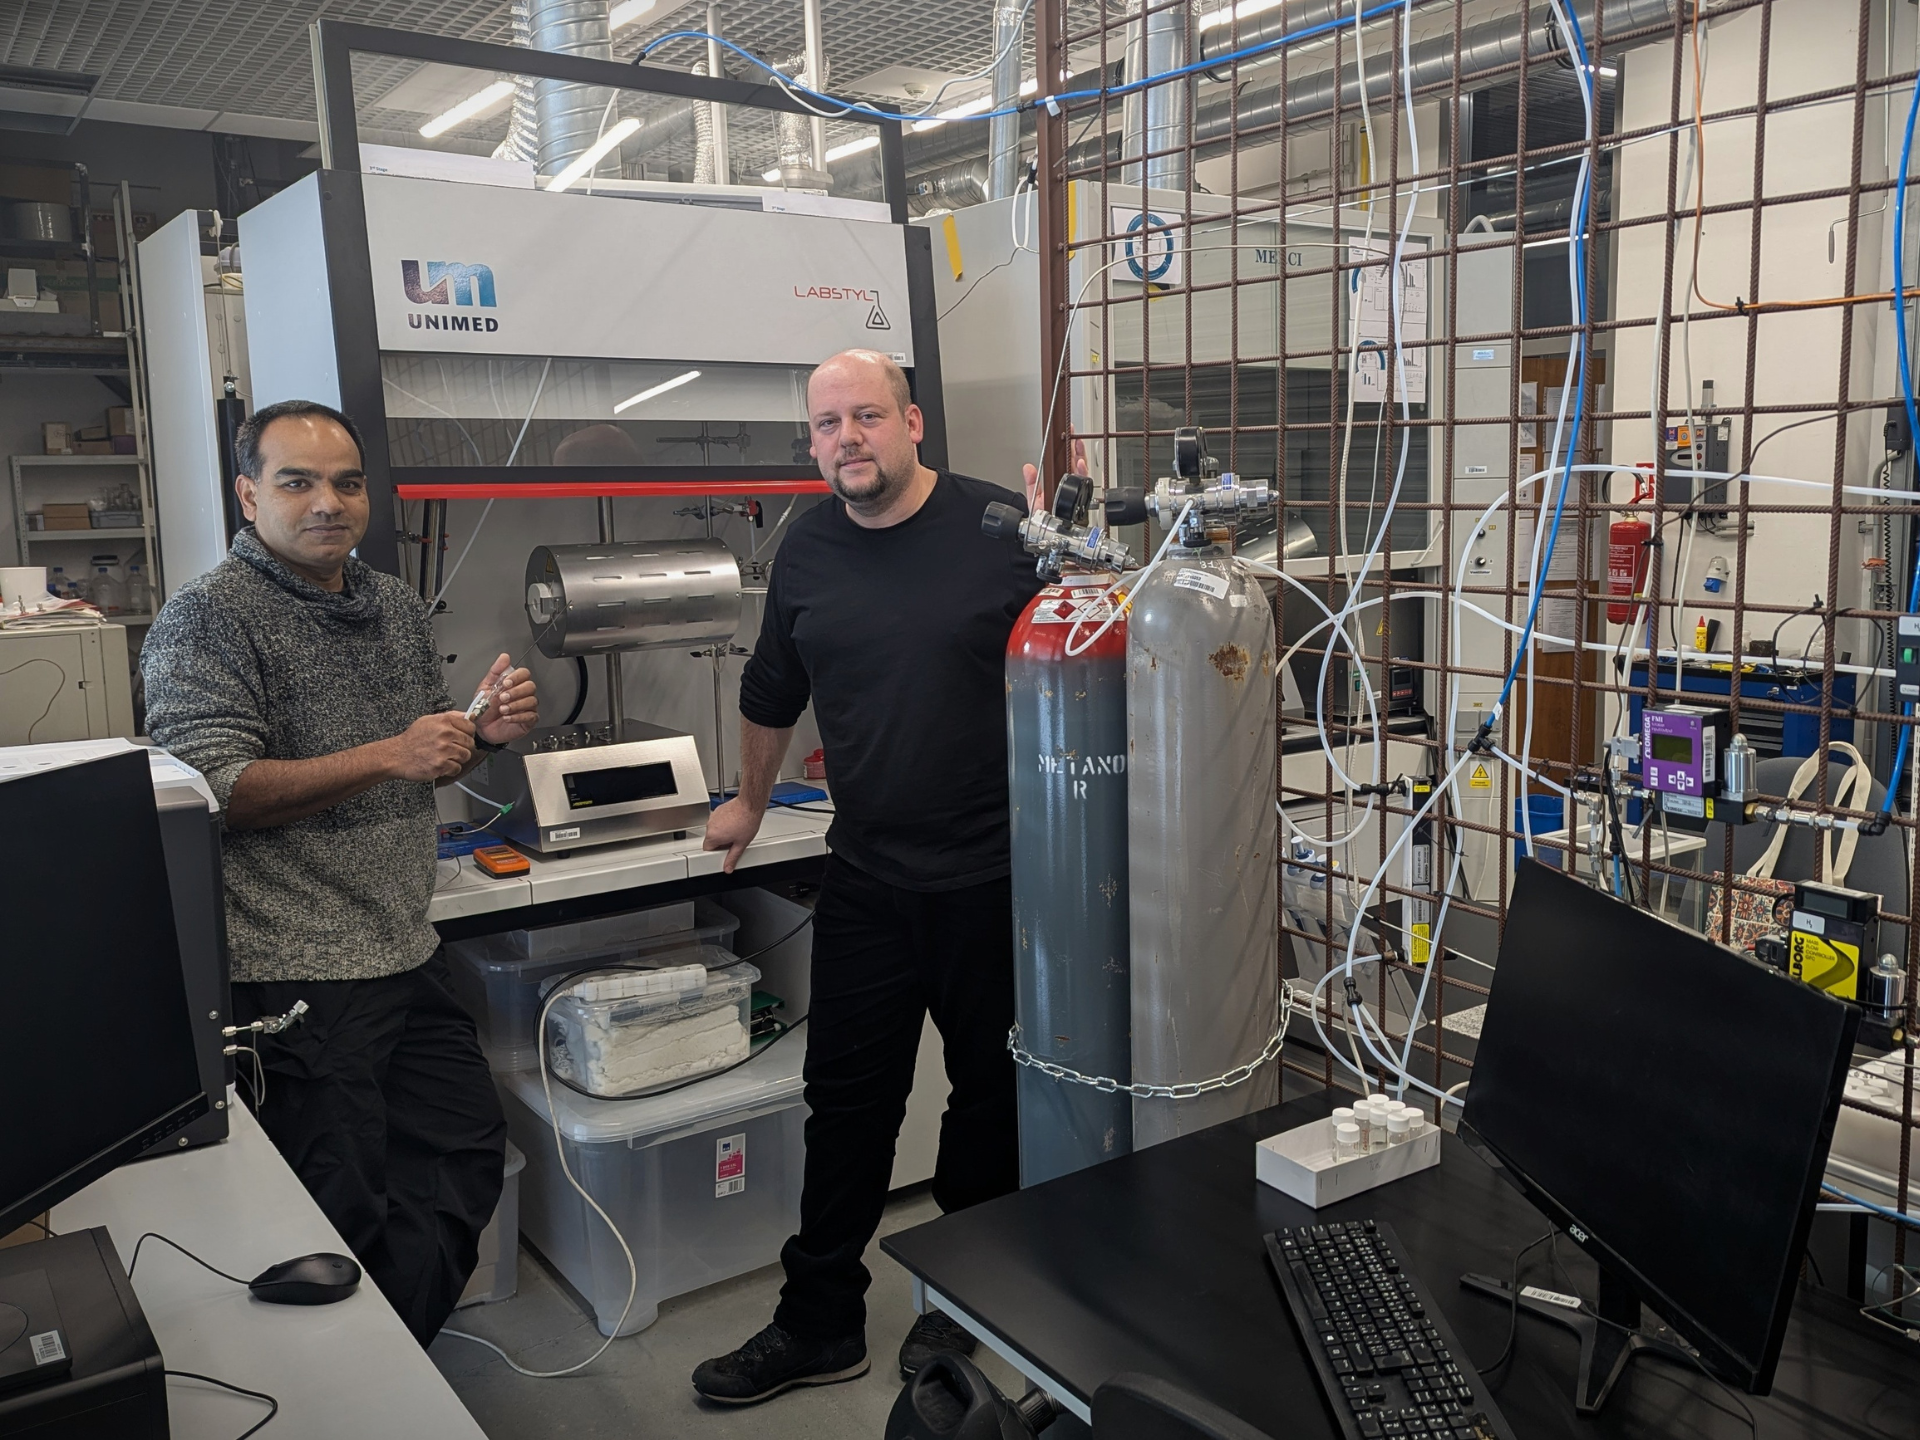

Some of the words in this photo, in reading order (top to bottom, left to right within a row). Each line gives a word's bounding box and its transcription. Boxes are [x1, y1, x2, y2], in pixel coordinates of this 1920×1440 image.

[1255, 248, 1302, 267] MECI
[407, 313, 499, 332] UNIMED
[1073, 780, 1087, 800] R
[1569, 1223, 1589, 1243] acer
